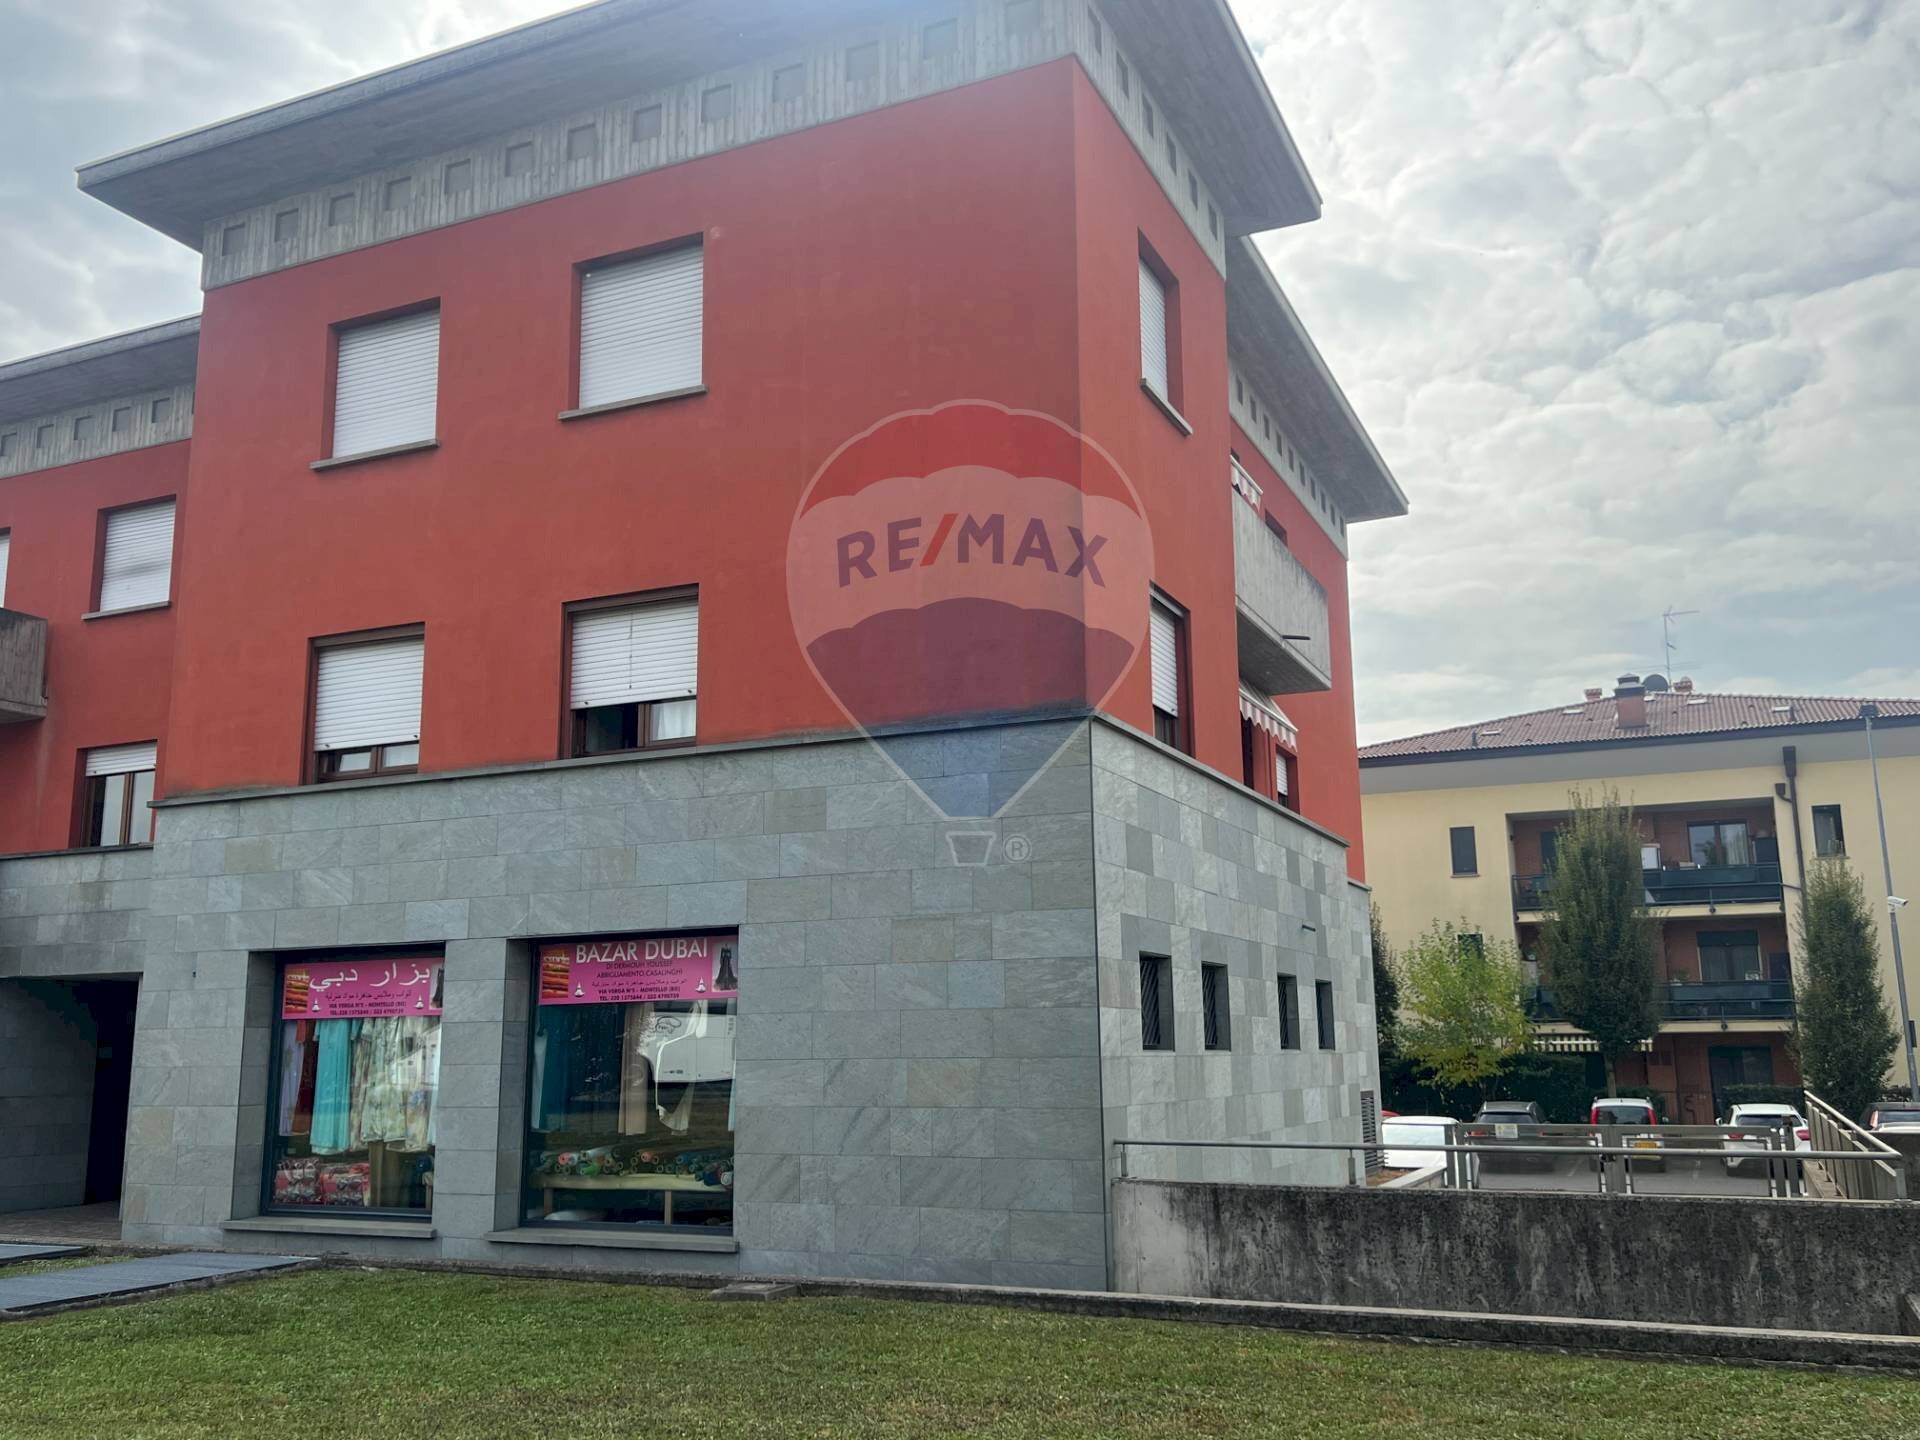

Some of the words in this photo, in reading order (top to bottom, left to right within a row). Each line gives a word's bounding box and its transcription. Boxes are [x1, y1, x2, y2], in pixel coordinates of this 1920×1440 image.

[576, 943, 638, 963] BAZAR
[645, 939, 707, 960] DUBAI
[309, 968, 359, 992] دبي
[370, 962, 431, 987] بزار
[597, 970, 645, 978] ABBIGLIAMENTO
[646, 969, 683, 977] CASALINGHI
